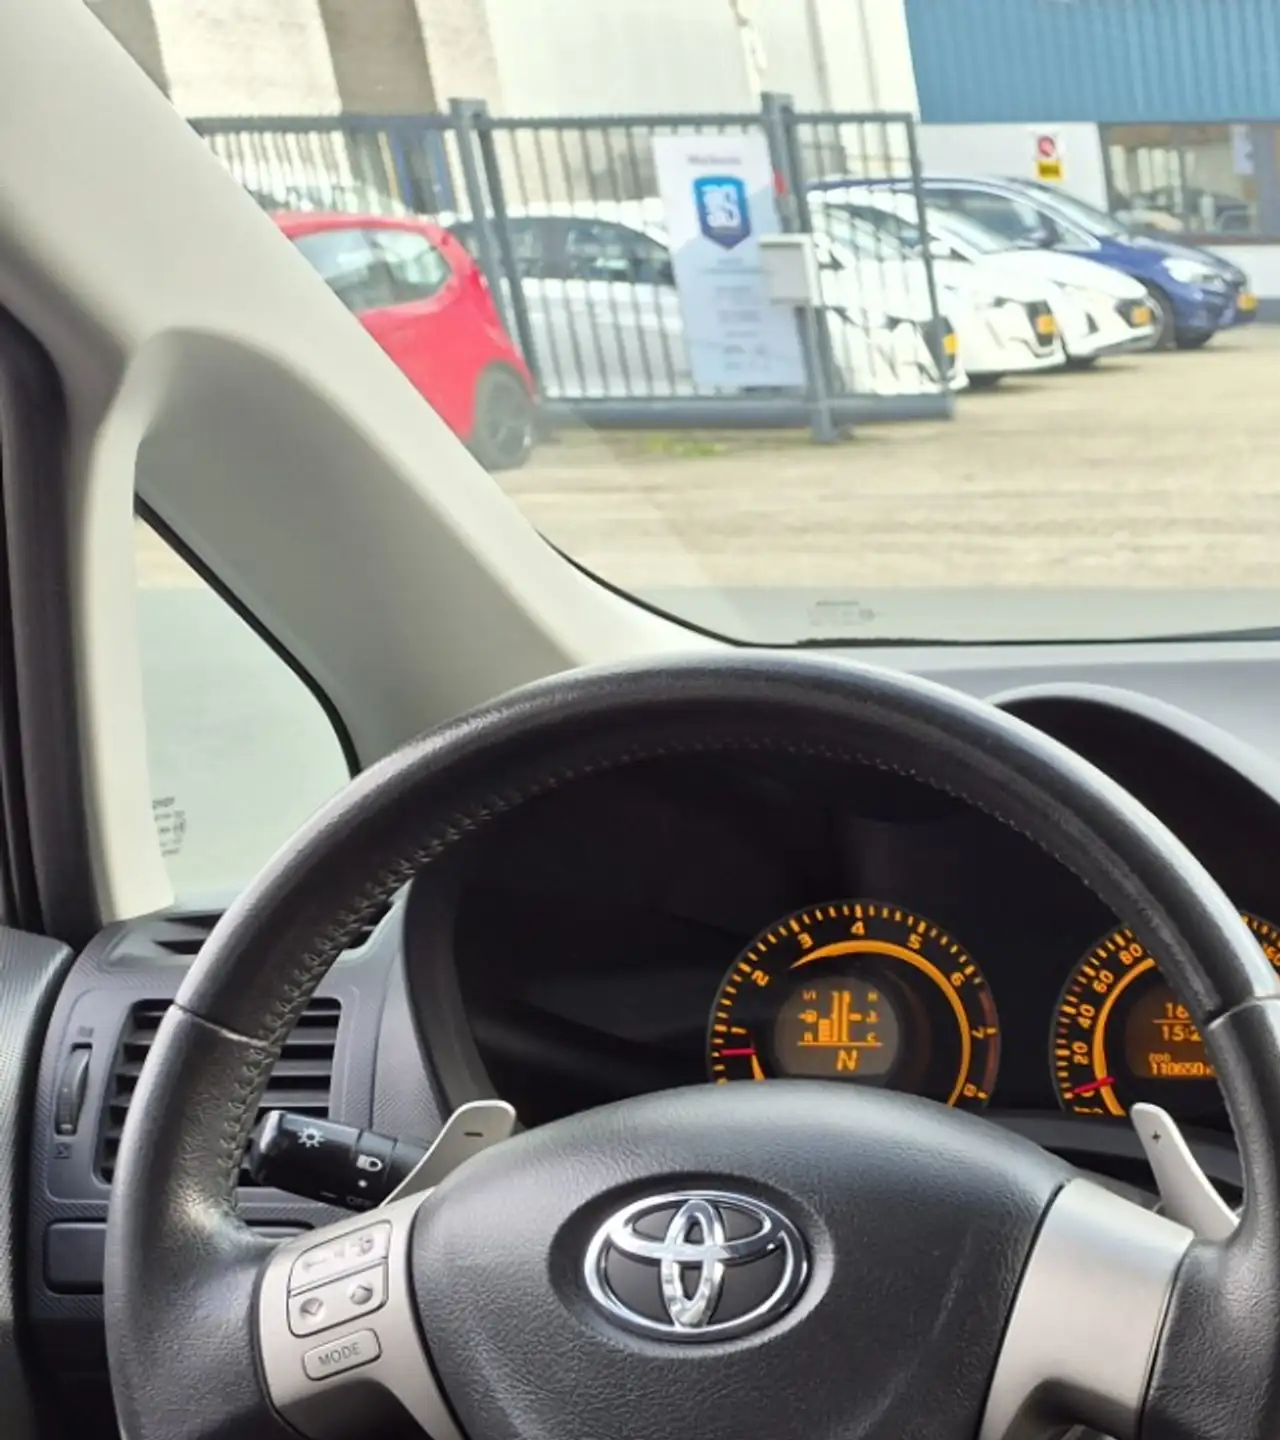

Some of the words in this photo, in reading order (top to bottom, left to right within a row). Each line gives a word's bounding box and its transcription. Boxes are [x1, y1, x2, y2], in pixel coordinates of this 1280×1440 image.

[851, 921, 865, 936] 4
[799, 932, 813, 948] 3
[907, 933, 923, 950] 5
[751, 969, 770, 988] 2
[951, 973, 965, 987] 6
[1092, 969, 1115, 994] 60
[1077, 1003, 1096, 1030] 40
[836, 1049, 859, 1072] N
[1071, 1041, 1089, 1066] 20
[318, 1342, 360, 1366] MODE
